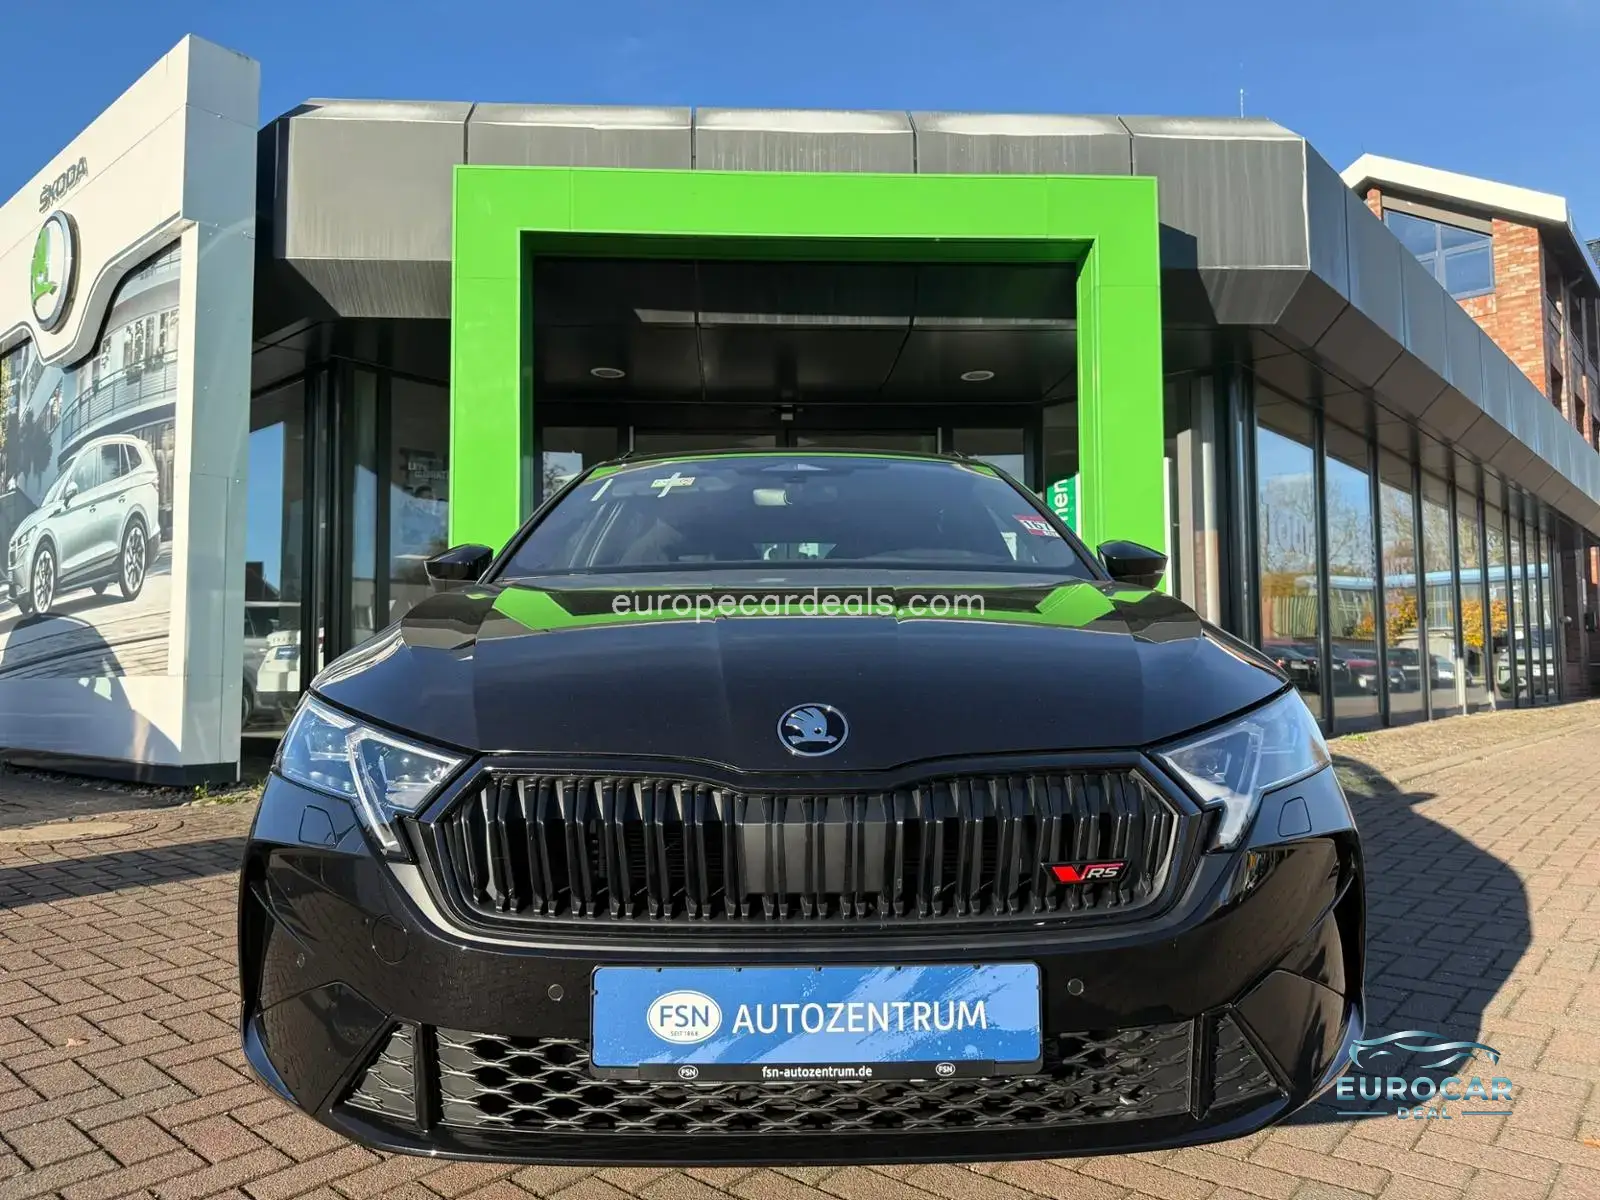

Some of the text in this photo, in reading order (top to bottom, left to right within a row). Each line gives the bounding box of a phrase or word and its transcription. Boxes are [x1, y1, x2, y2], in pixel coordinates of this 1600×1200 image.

[660, 1000, 988, 1034] FSN AUTOZENTRUM
[681, 1068, 696, 1077] FSN
[761, 1065, 873, 1079] fsn-autozentrum.de
[938, 1065, 953, 1073] FSN
